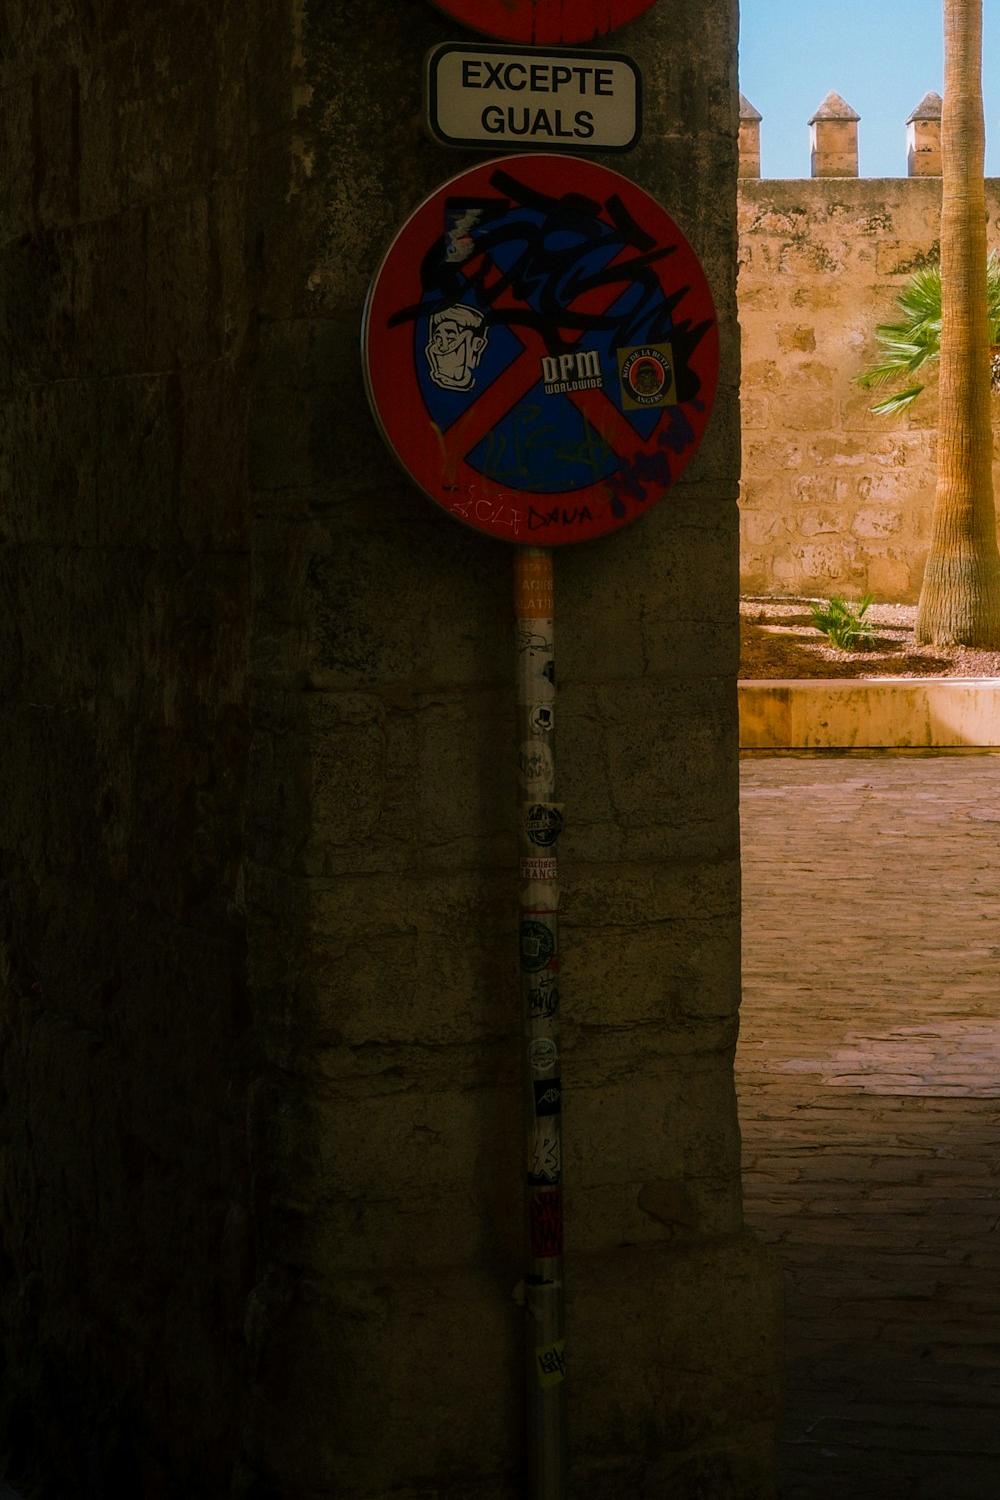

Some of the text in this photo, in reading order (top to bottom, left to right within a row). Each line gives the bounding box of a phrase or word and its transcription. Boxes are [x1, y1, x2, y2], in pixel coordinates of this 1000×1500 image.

[462, 60, 614, 96] EXCEPTE
[481, 105, 595, 138] GUALS
[541, 350, 602, 383] DPM
[630, 351, 641, 362] DE
[544, 378, 603, 395] WORLDWIDE
[635, 392, 664, 404] ANGERS
